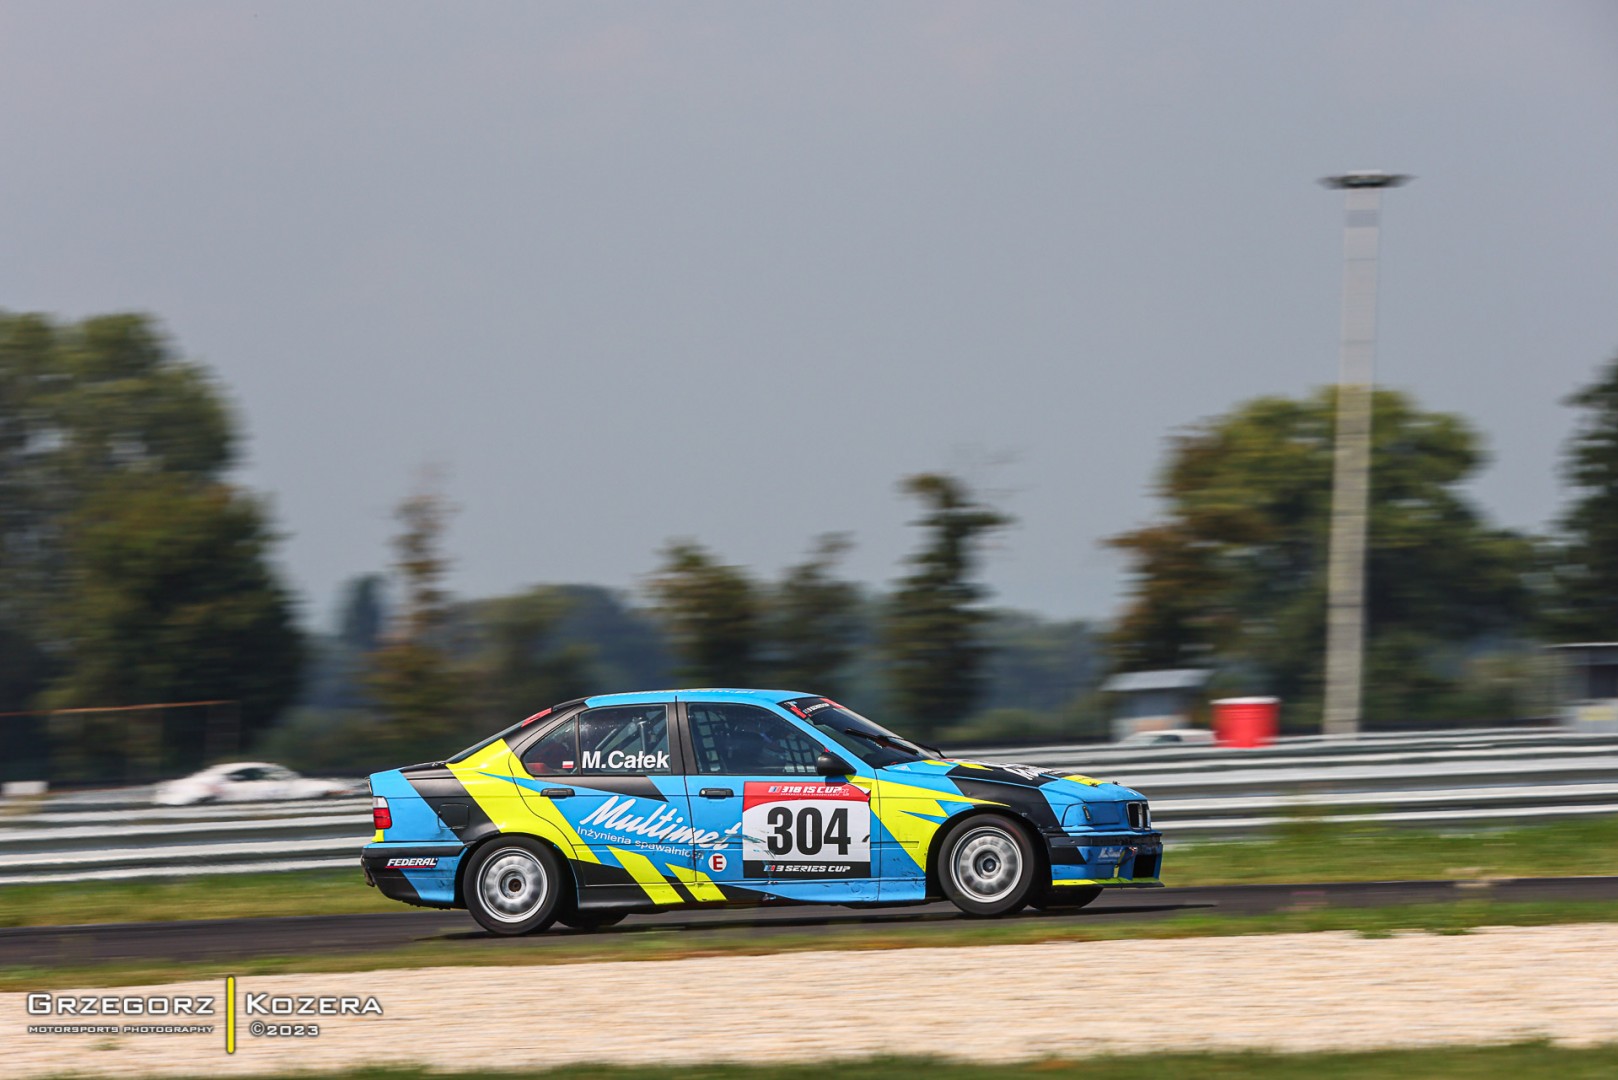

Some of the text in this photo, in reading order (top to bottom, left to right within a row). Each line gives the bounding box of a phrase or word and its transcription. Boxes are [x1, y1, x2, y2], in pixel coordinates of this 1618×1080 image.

[581, 750, 670, 769] M.Całek
[781, 785, 802, 794] 318
[816, 785, 842, 794] CUP
[579, 795, 742, 850] Multimet
[767, 806, 852, 856] 304
[577, 825, 632, 845] Inżynieria
[386, 857, 438, 867] FEDERAL
[712, 855, 724, 870] E
[785, 865, 827, 873] SERIES
[827, 865, 851, 873] CUP
